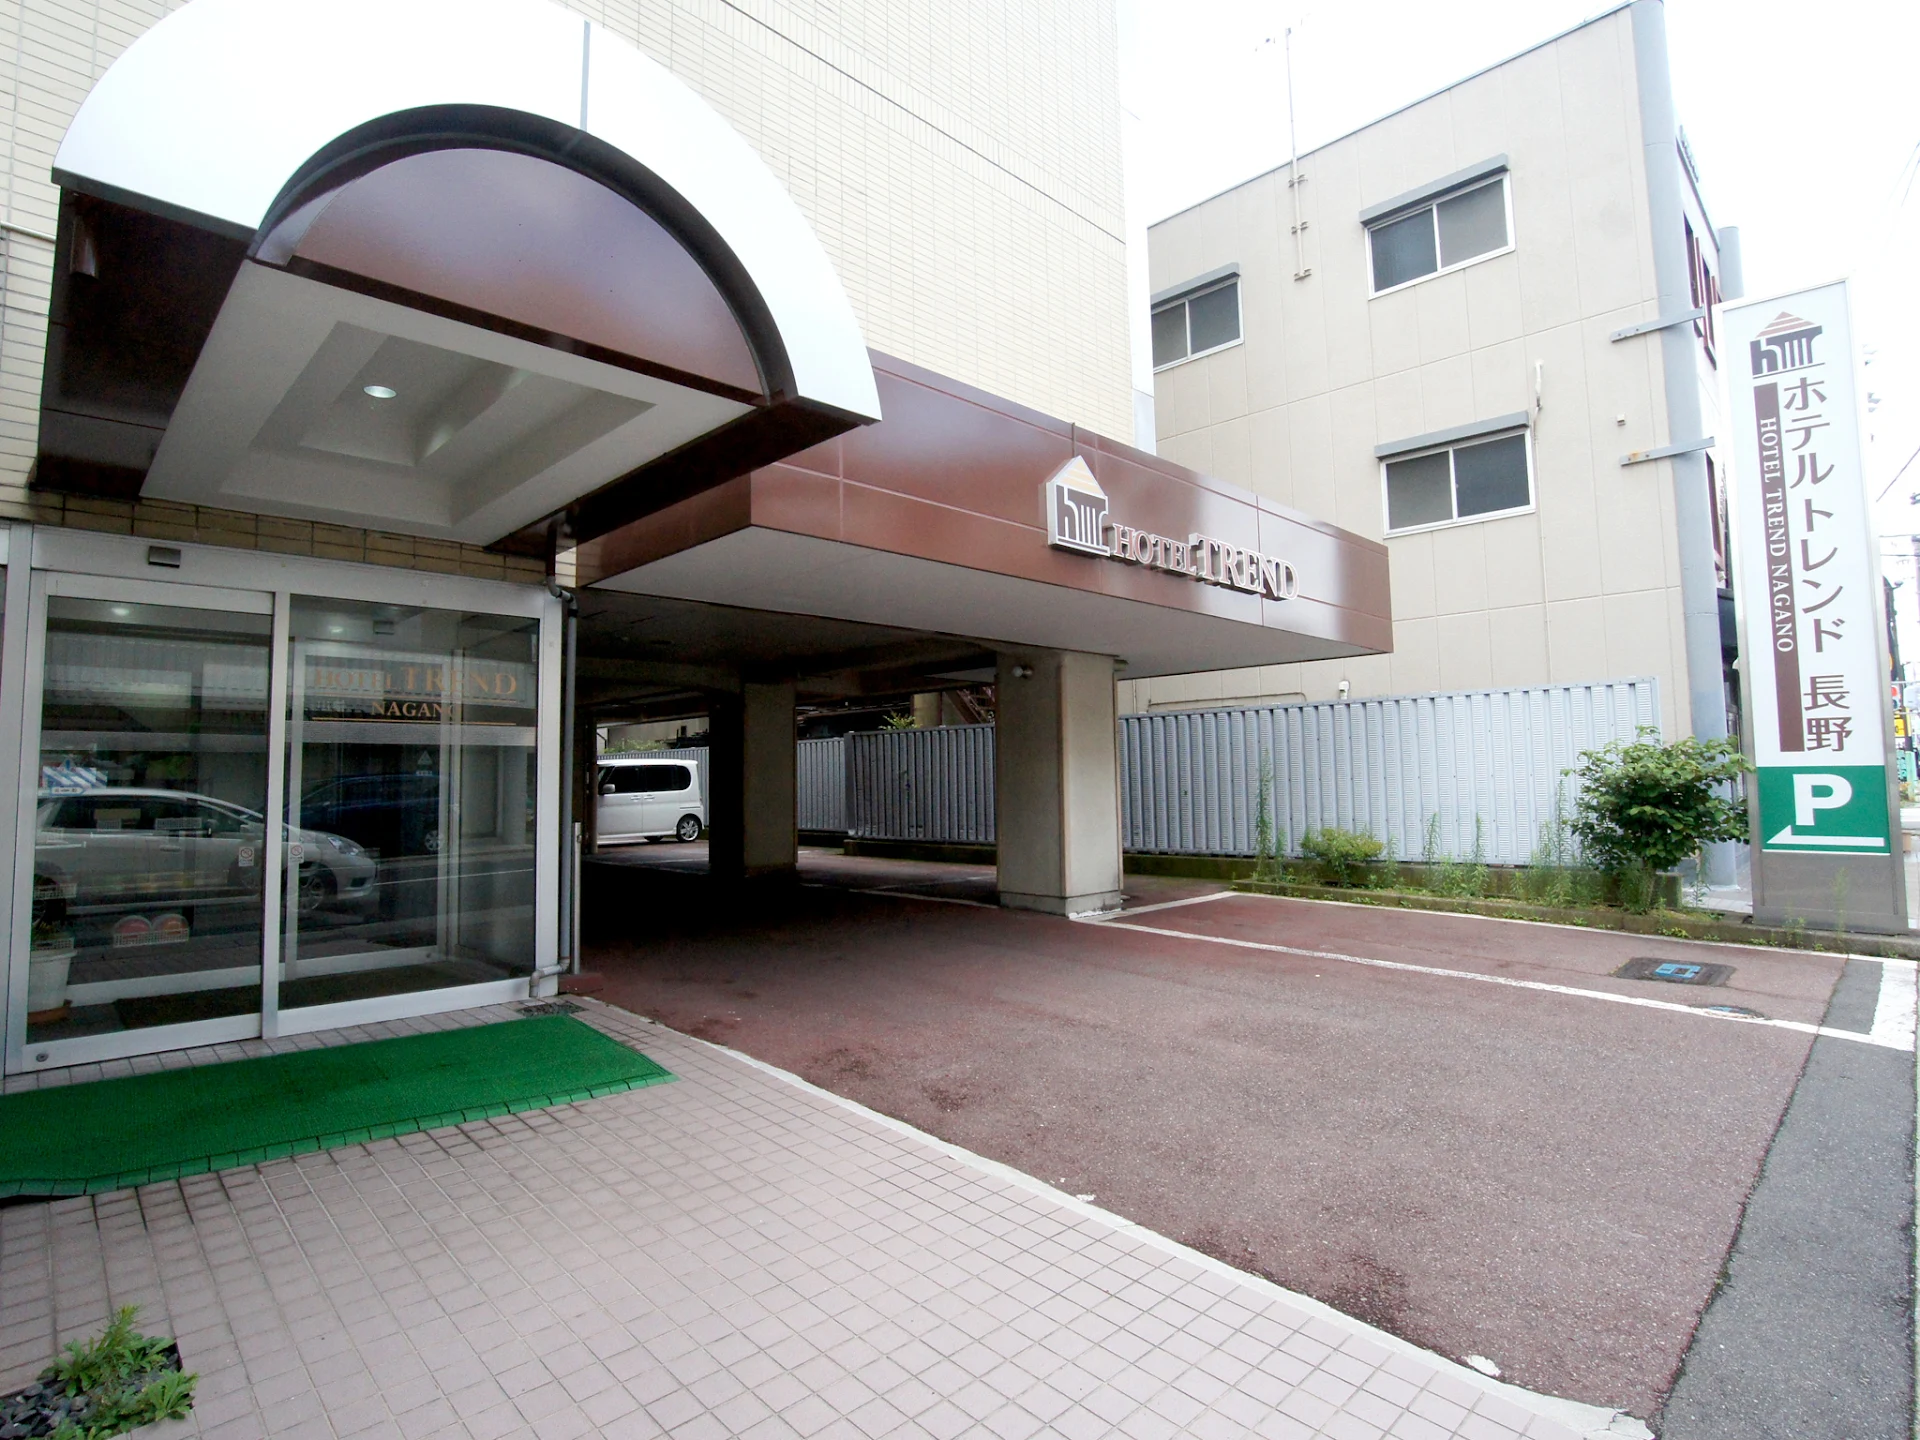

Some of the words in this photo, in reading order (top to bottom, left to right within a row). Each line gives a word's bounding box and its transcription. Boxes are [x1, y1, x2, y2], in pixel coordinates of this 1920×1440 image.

[1760, 417, 1782, 483] HOTEL
[1766, 489, 1787, 557] TREND
[1112, 523, 1196, 576] HOTEL
[1196, 533, 1299, 600] TREND
[1772, 565, 1794, 652] NAGANO
[314, 668, 397, 691] HOTEL
[402, 665, 518, 695] TREND
[1804, 674, 1852, 752] 長野
[1793, 774, 1852, 825] P
